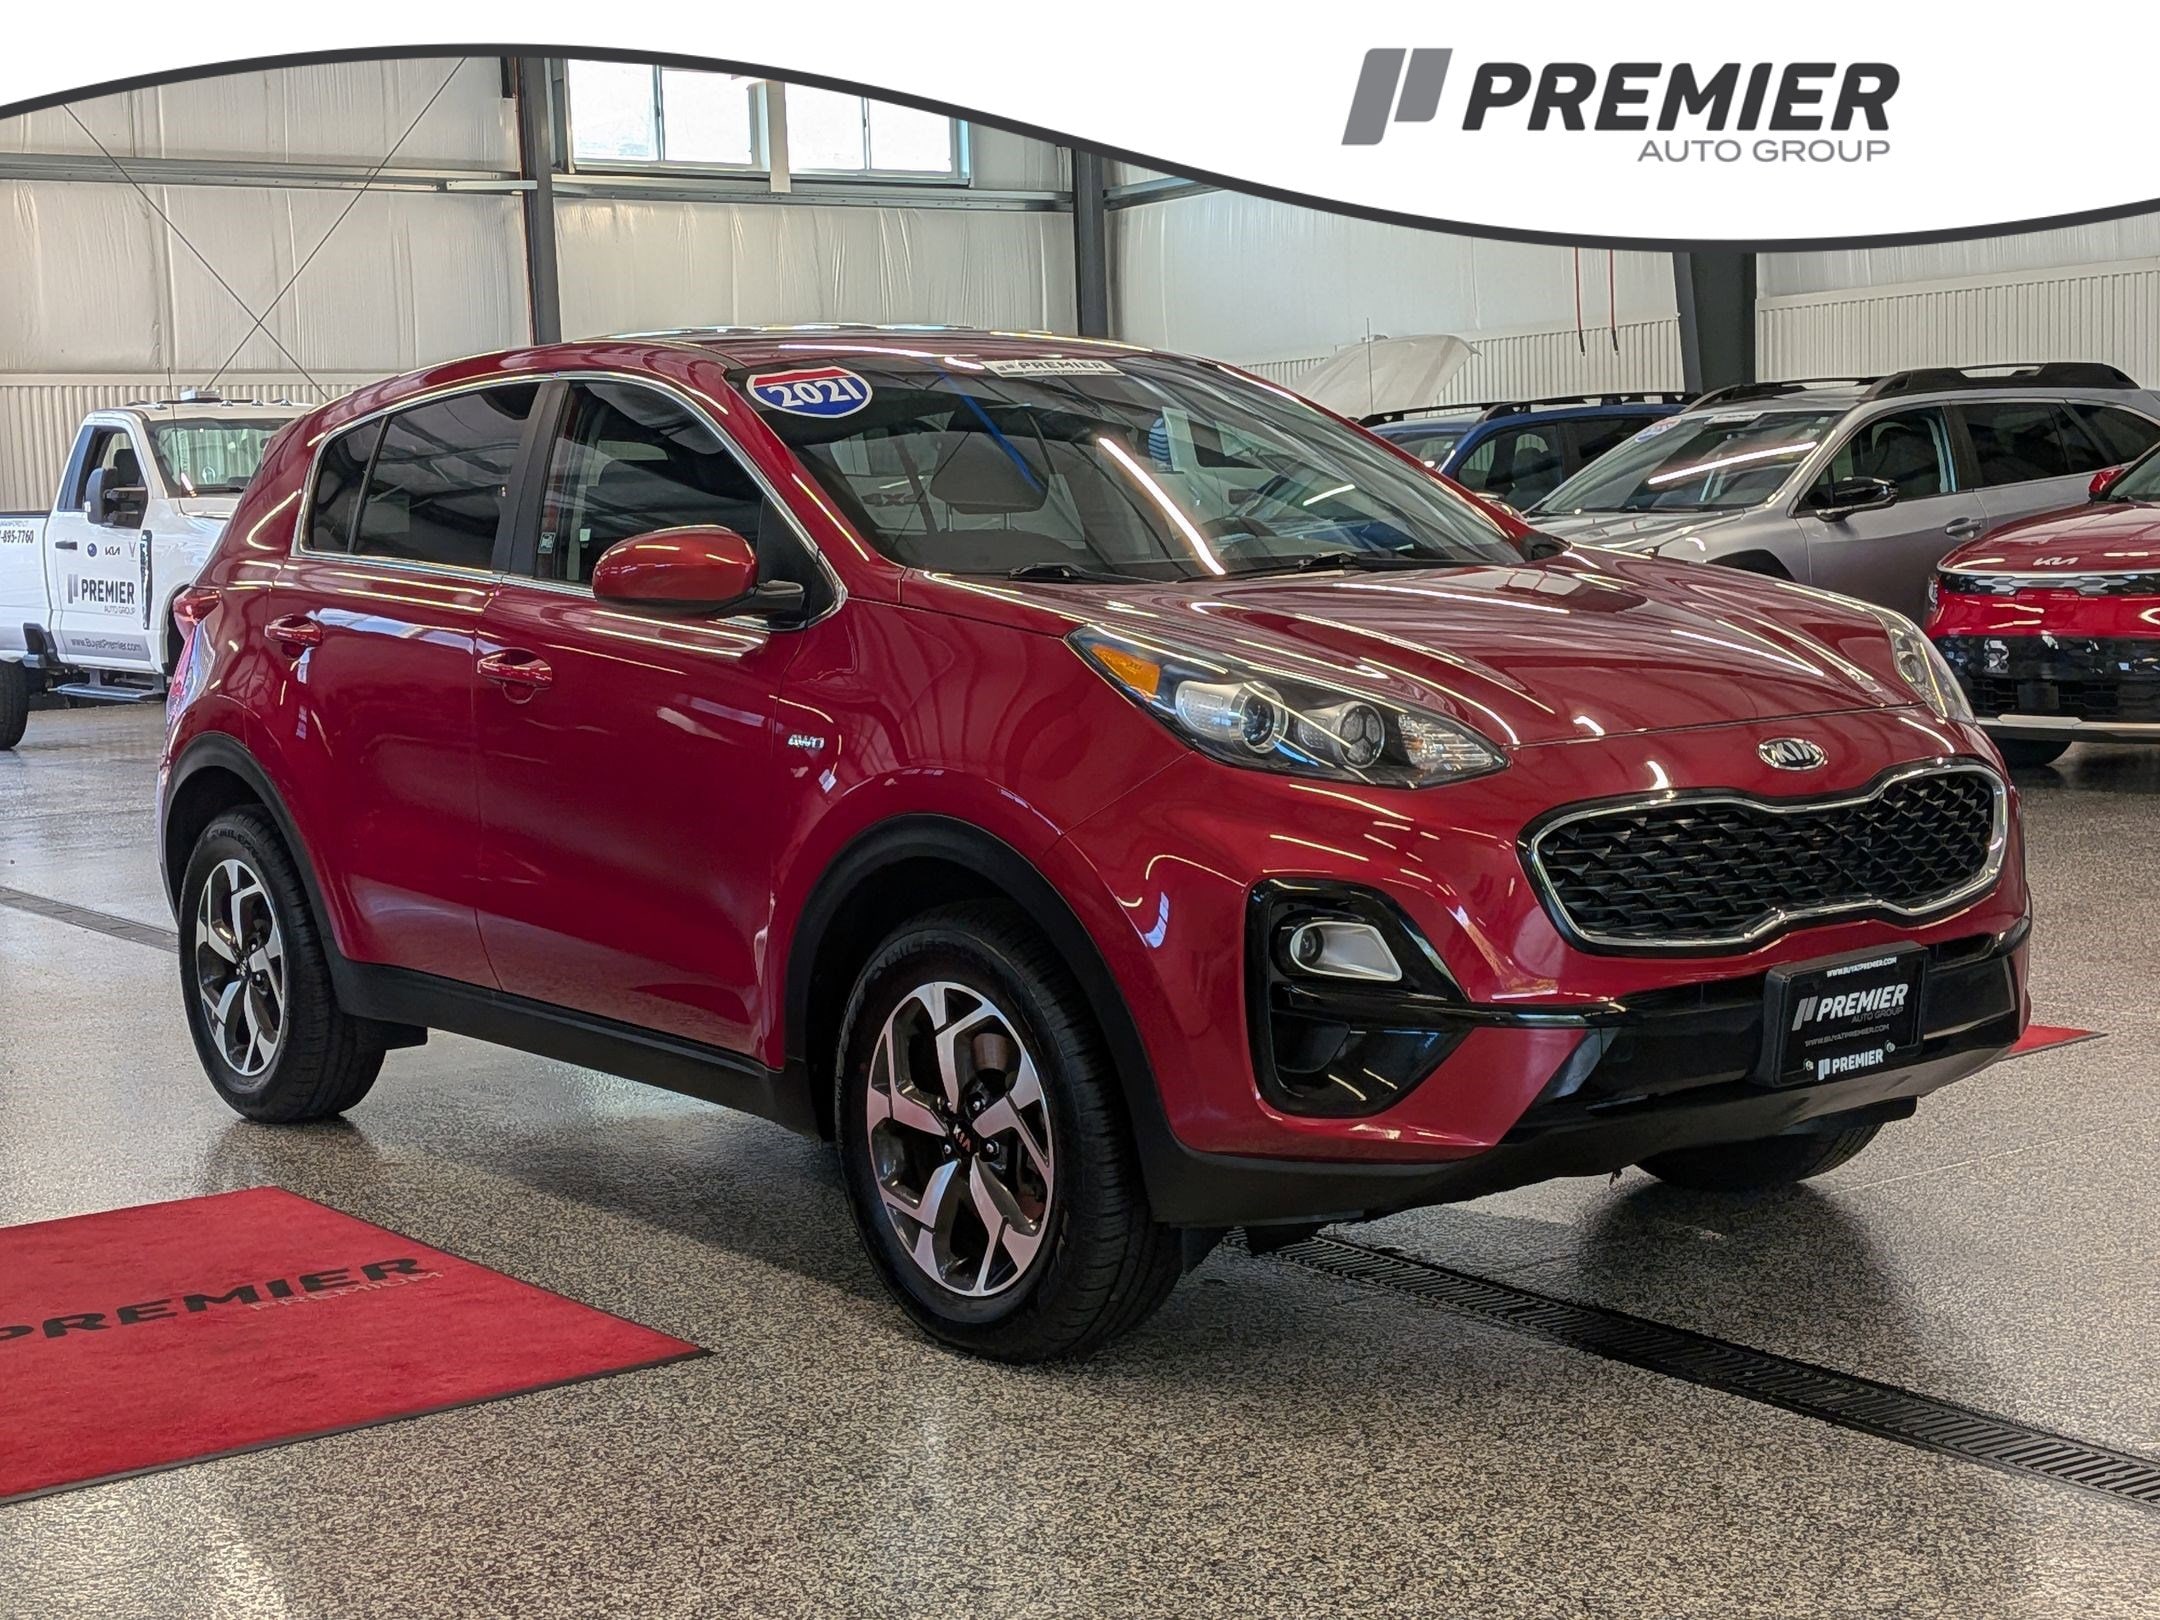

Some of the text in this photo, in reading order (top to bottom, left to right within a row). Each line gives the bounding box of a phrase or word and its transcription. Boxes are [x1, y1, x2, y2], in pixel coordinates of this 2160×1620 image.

[1019, 360, 1107, 370] PREMIER
[767, 379, 863, 407] 2021
[0, 529, 34, 544] -895-7760
[2033, 557, 2079, 566] KIA
[81, 579, 135, 604] PREMIER
[788, 734, 825, 749] AWD
[1766, 741, 1821, 764] KIA
[1817, 983, 1909, 1022] PREMIER
[1851, 1006, 1904, 1023] AUTO GROUP
[1832, 1048, 1884, 1074] PREMIER
